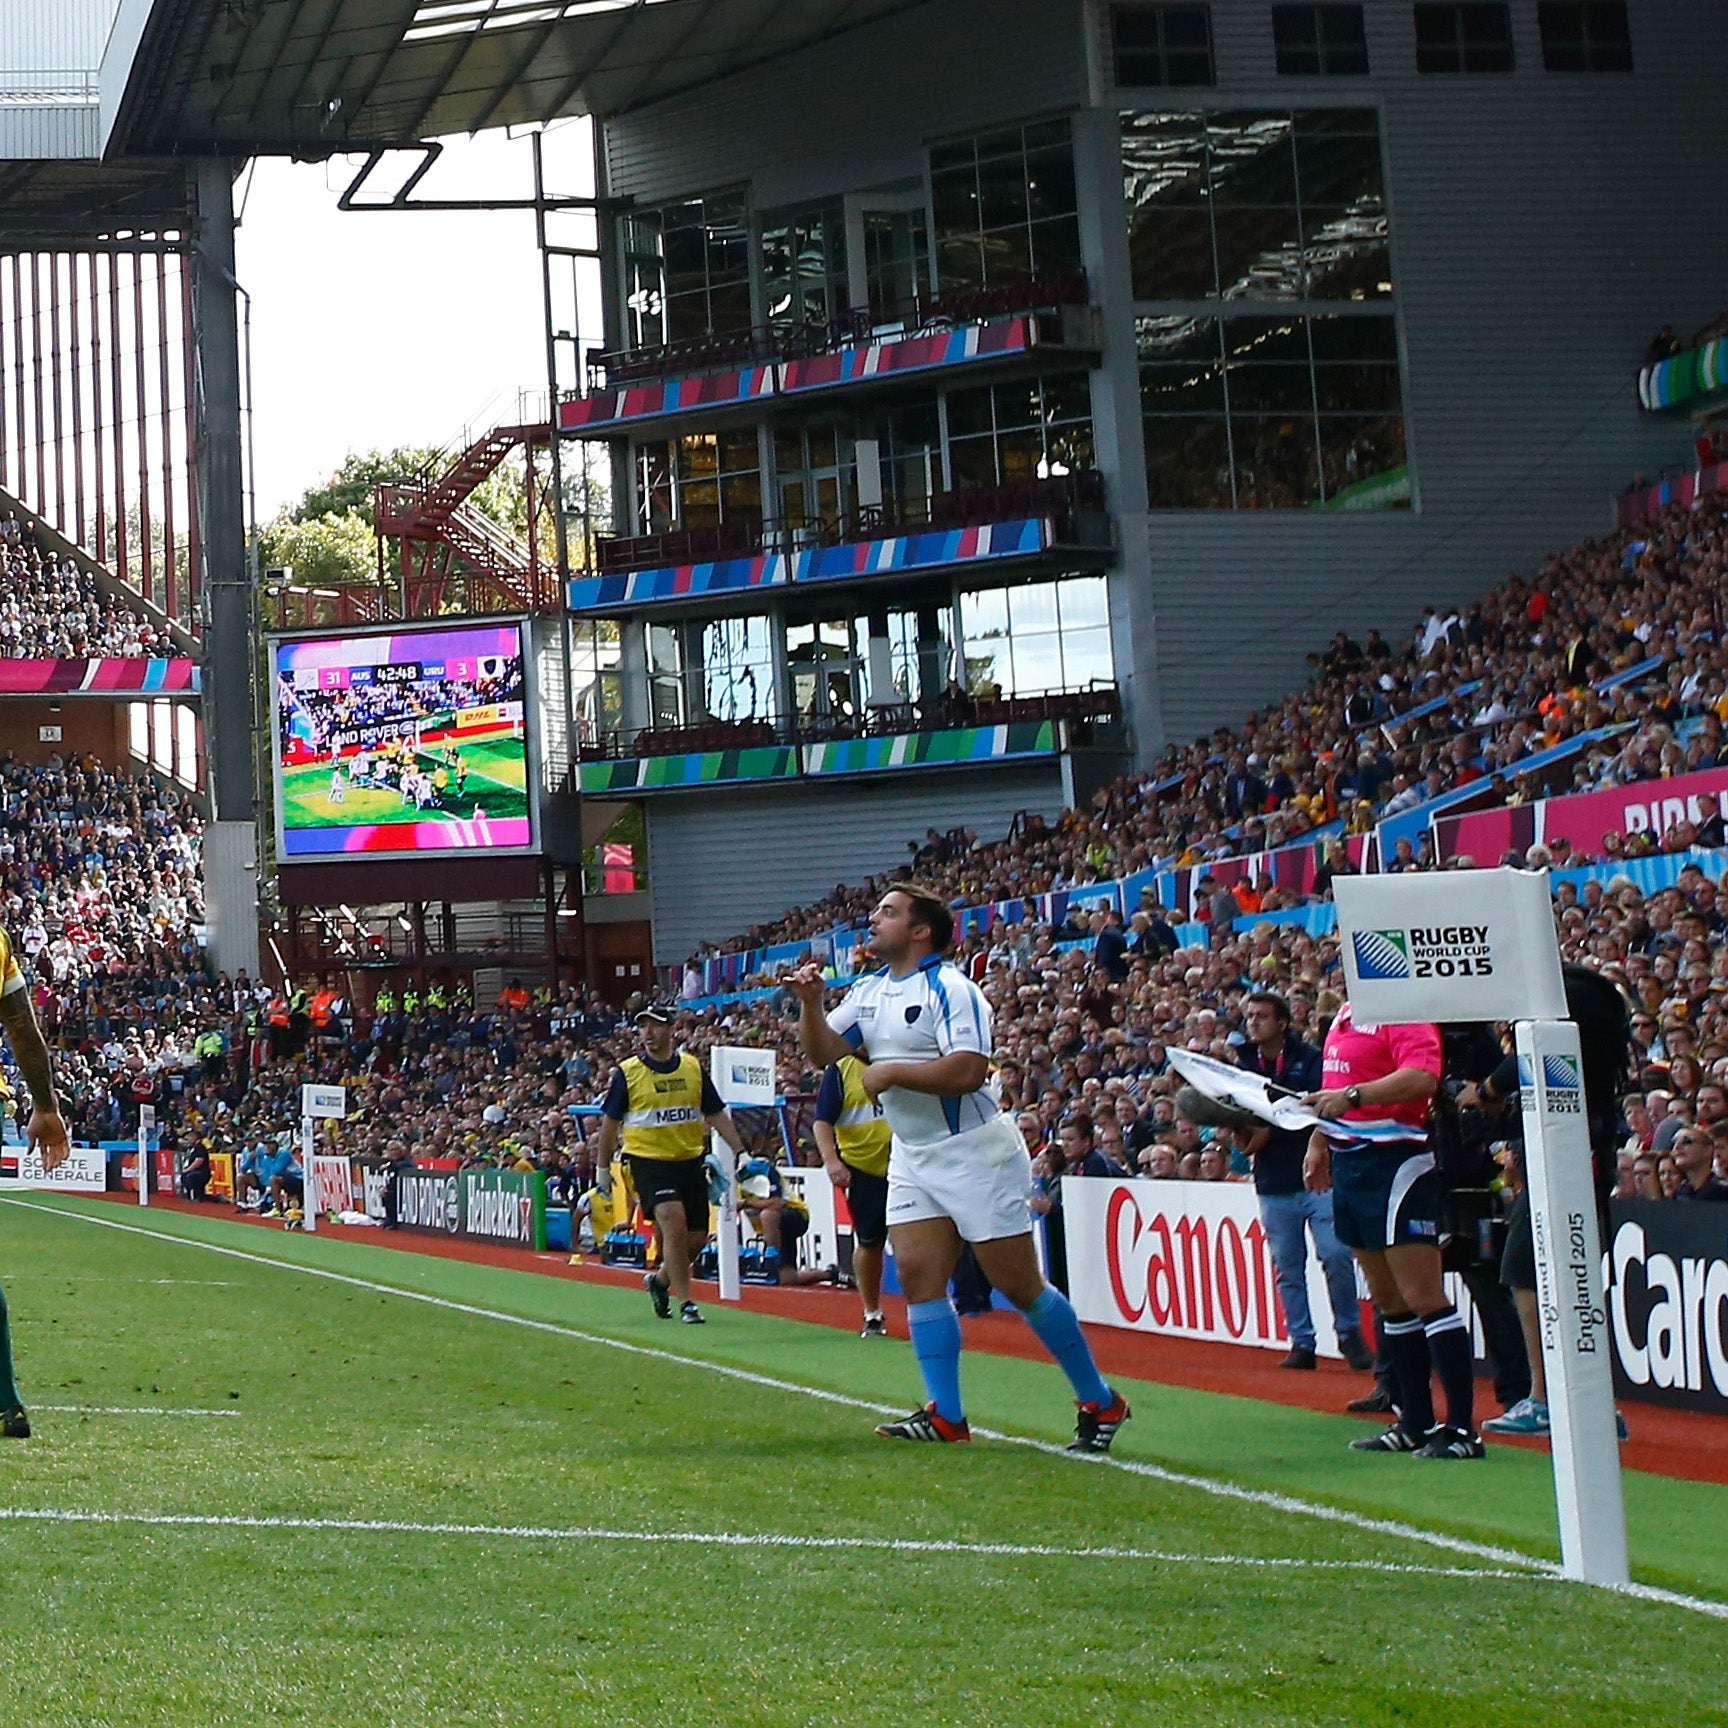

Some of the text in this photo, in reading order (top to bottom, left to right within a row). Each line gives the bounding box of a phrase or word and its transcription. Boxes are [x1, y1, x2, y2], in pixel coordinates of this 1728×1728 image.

[326, 664, 467, 685] 31 AUS 42:48 URU 3
[1410, 926, 1489, 946] RUGBY
[1413, 946, 1491, 958] WORLD CUP
[1415, 958, 1493, 977] 2015
[1546, 1090, 1579, 1099] RUGBY
[1547, 1104, 1581, 1113] 2015
[397, 1175, 419, 1225] LAND
[419, 1175, 445, 1228] ROVER
[466, 1175, 519, 1239] Heineken
[1568, 1212, 1605, 1354] England 2015
[1540, 1260, 1558, 1351] England
